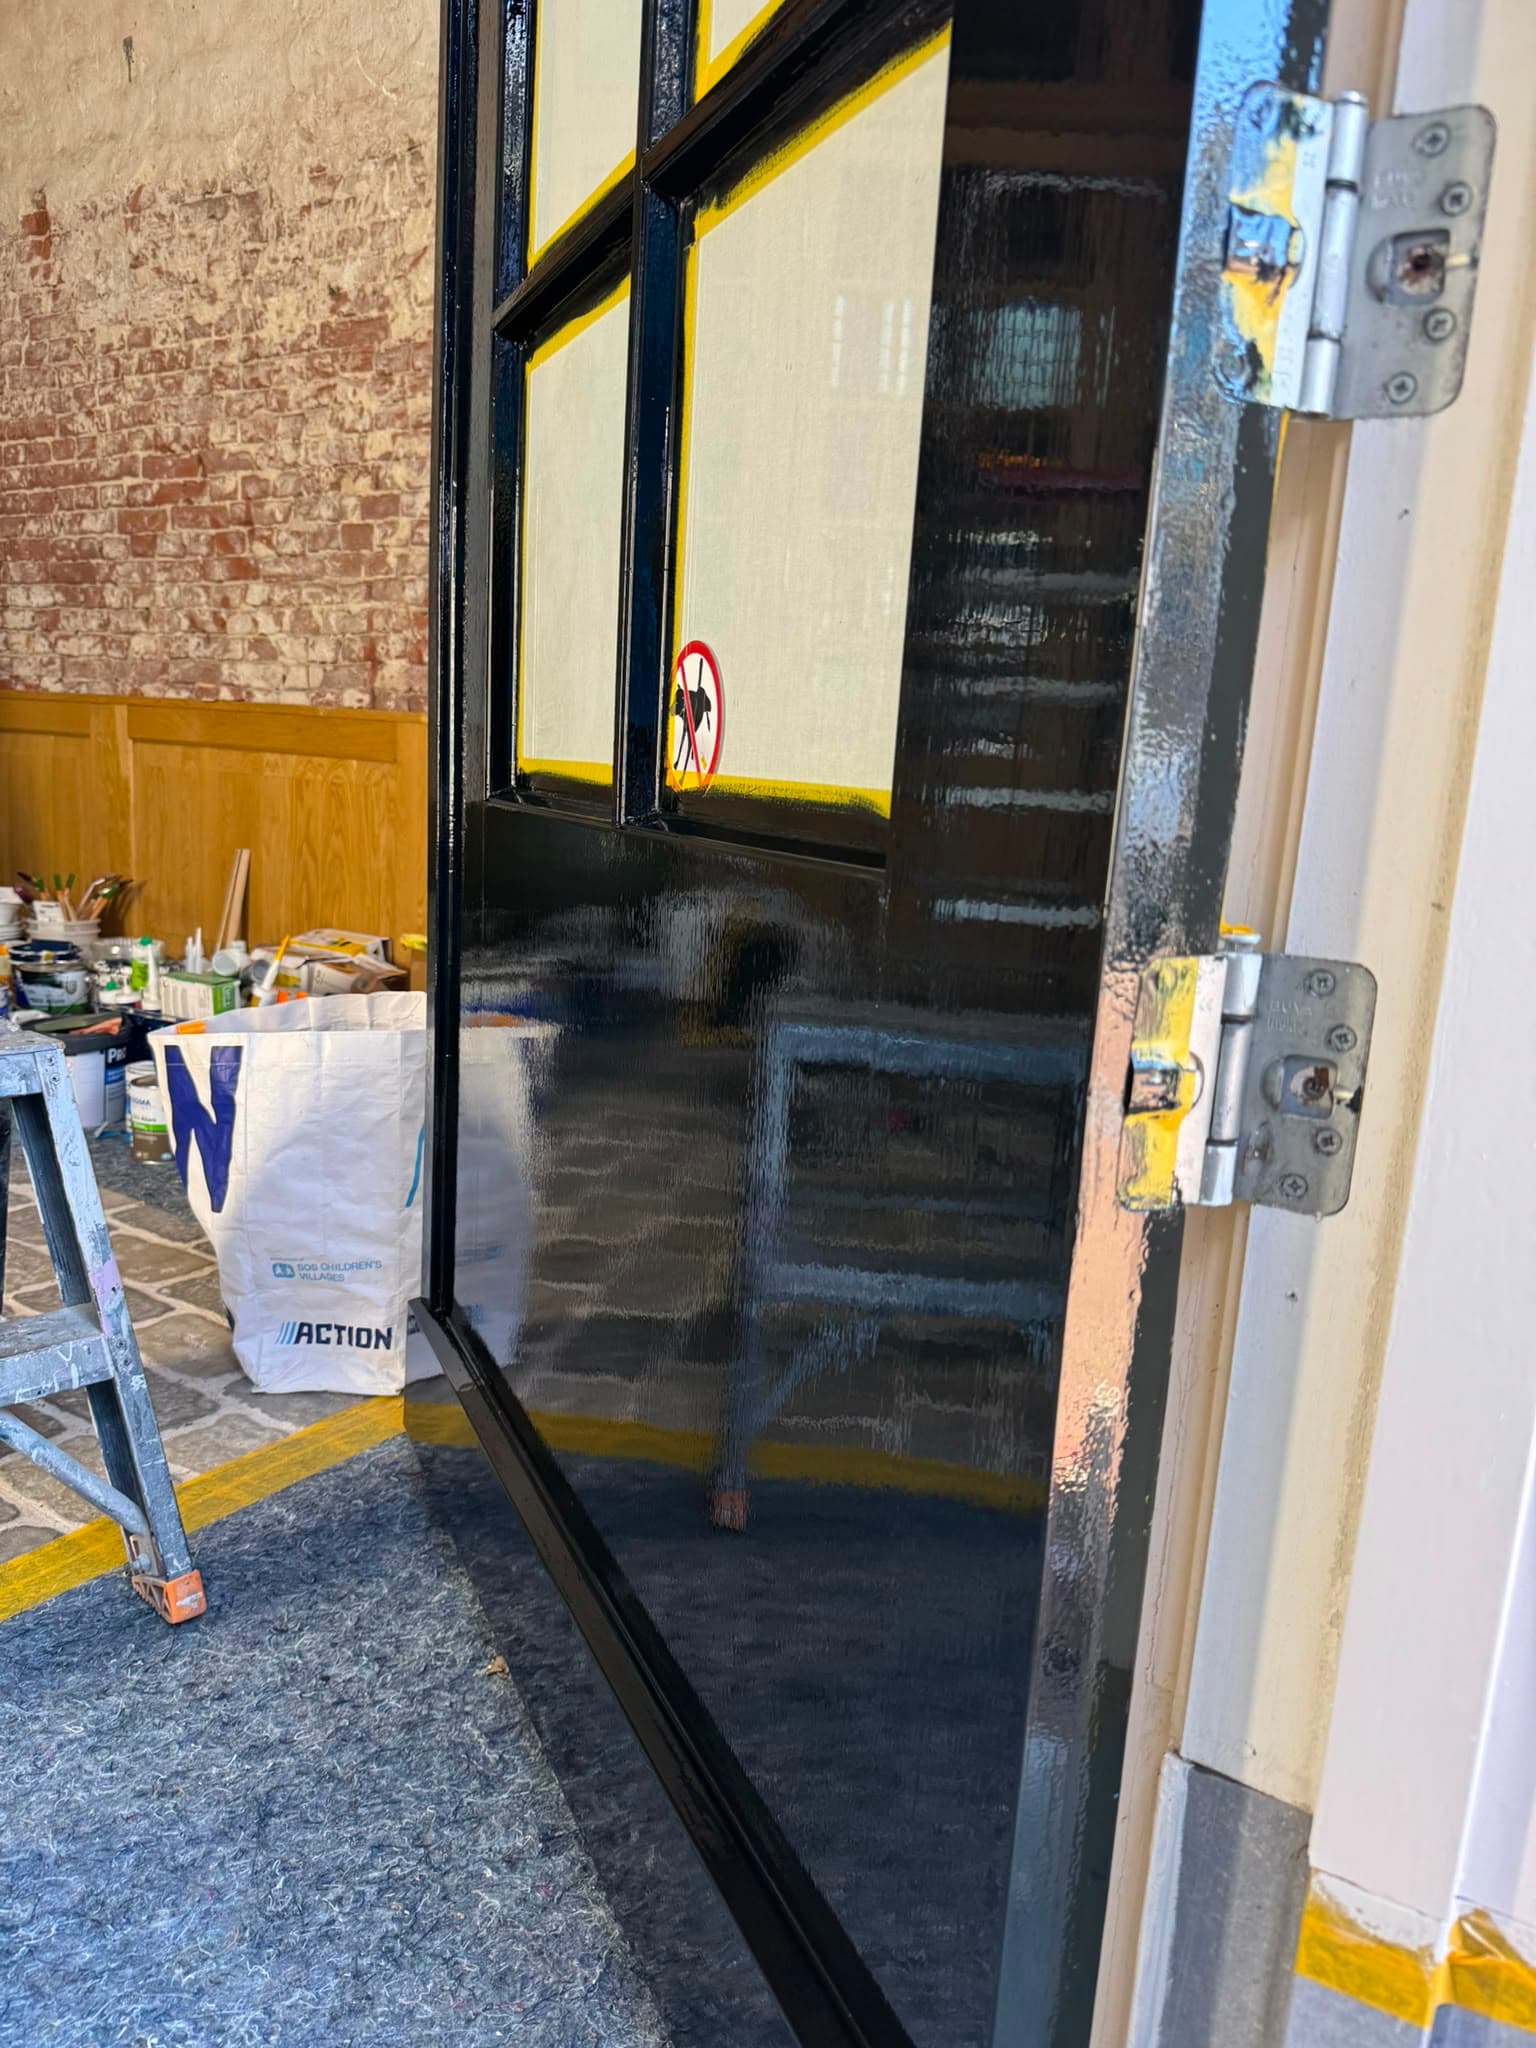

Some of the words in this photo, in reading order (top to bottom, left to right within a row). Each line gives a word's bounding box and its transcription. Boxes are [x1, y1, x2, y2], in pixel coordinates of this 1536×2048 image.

[297, 1263, 318, 1272] SOS
[320, 1259, 382, 1272] CHILDREN'S
[299, 1272, 345, 1281] VILLAGES
[294, 1321, 392, 1350] ACTION
